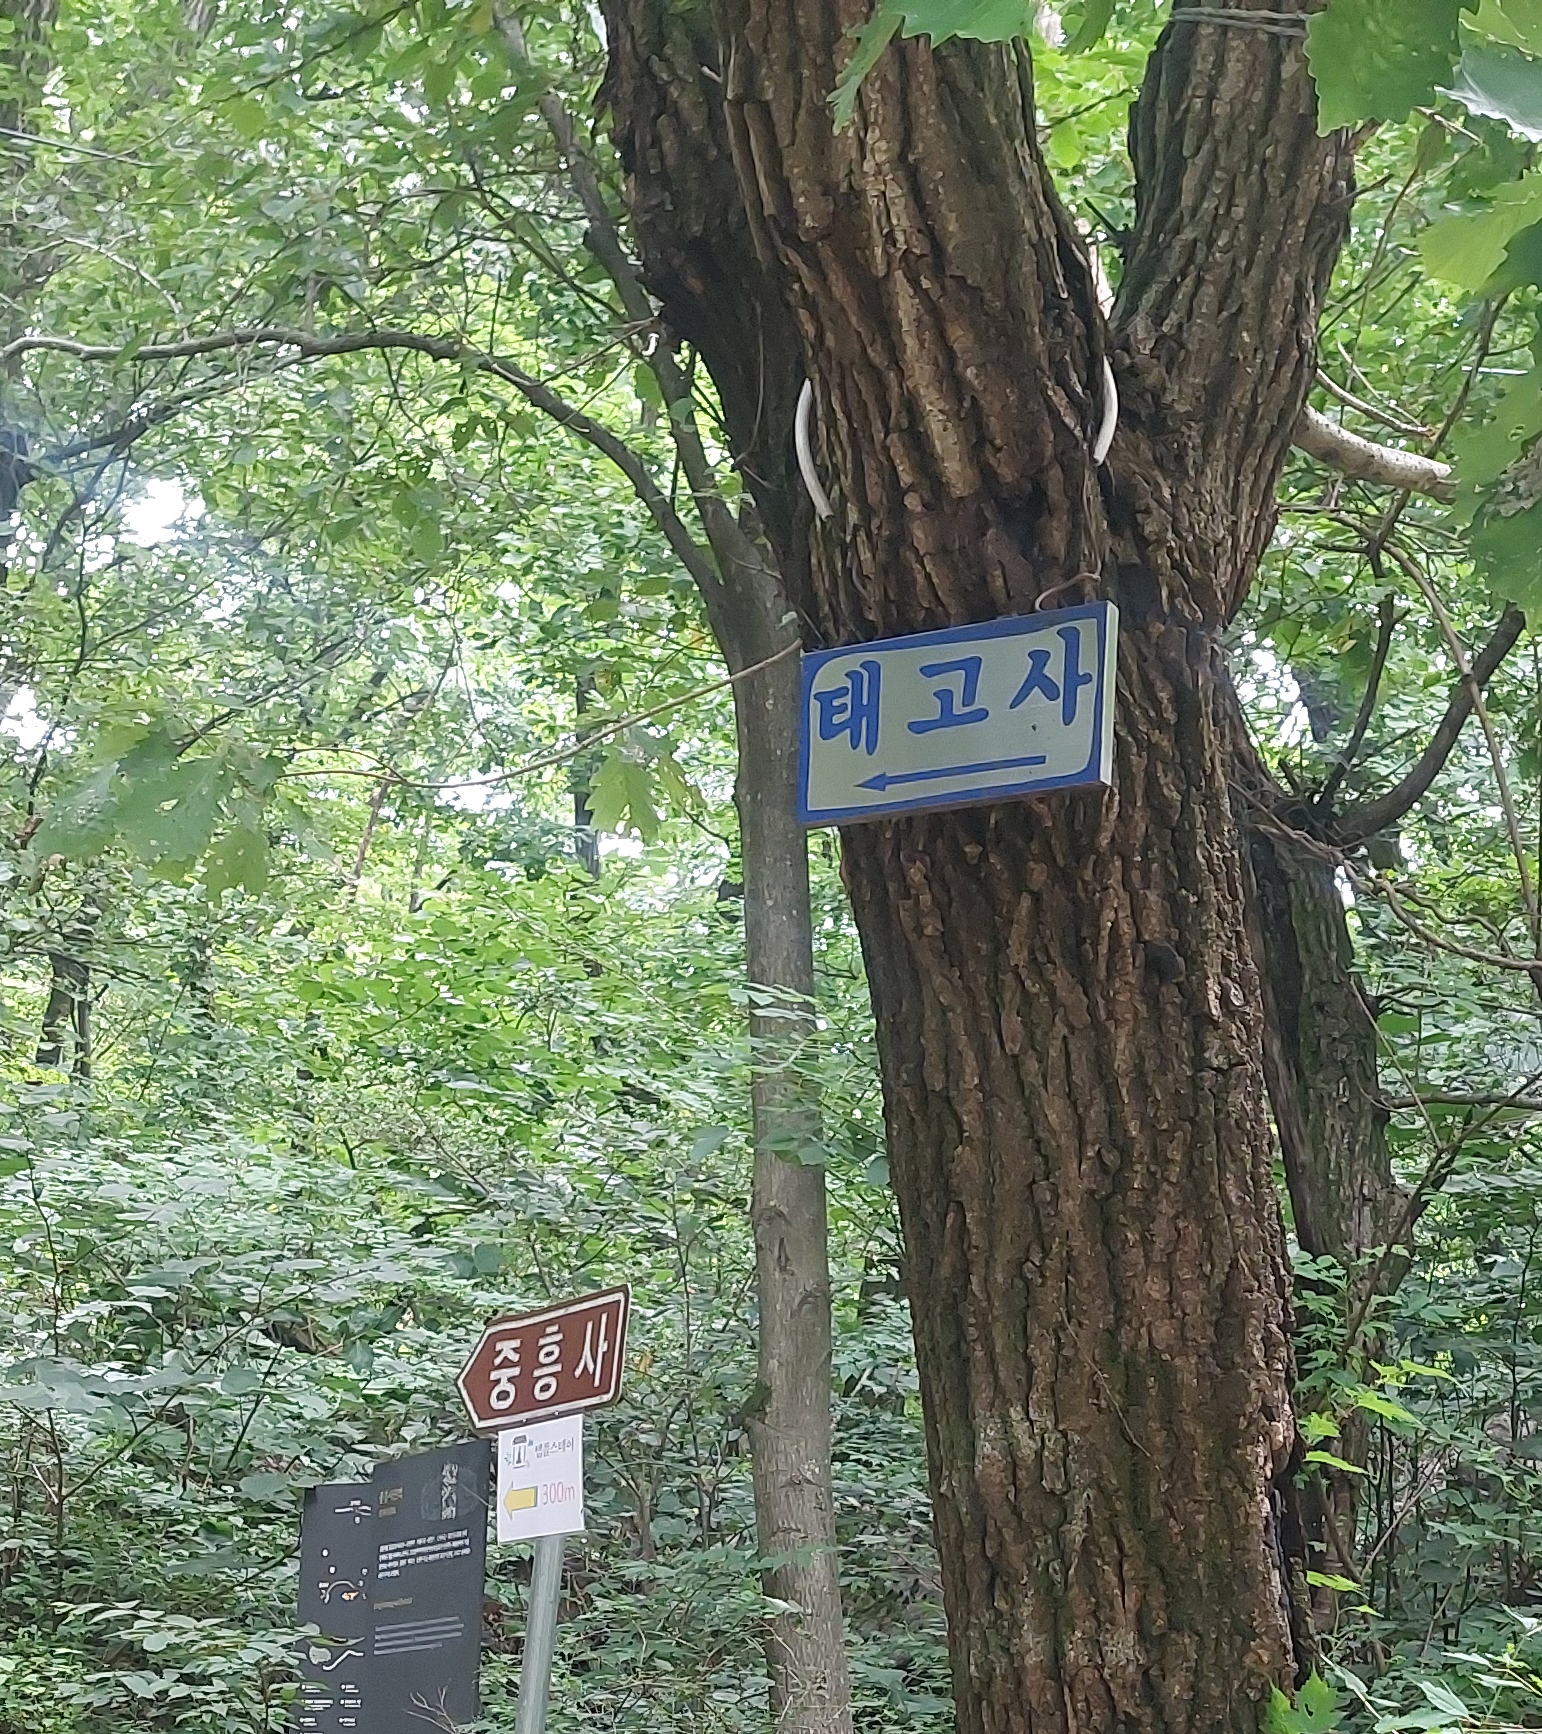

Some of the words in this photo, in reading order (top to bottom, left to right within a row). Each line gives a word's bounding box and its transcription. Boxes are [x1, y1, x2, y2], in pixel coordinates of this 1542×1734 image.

[813, 626, 1093, 756] 태고사
[488, 1312, 611, 1412] 중흥사
[542, 1481, 576, 1506] 300m
